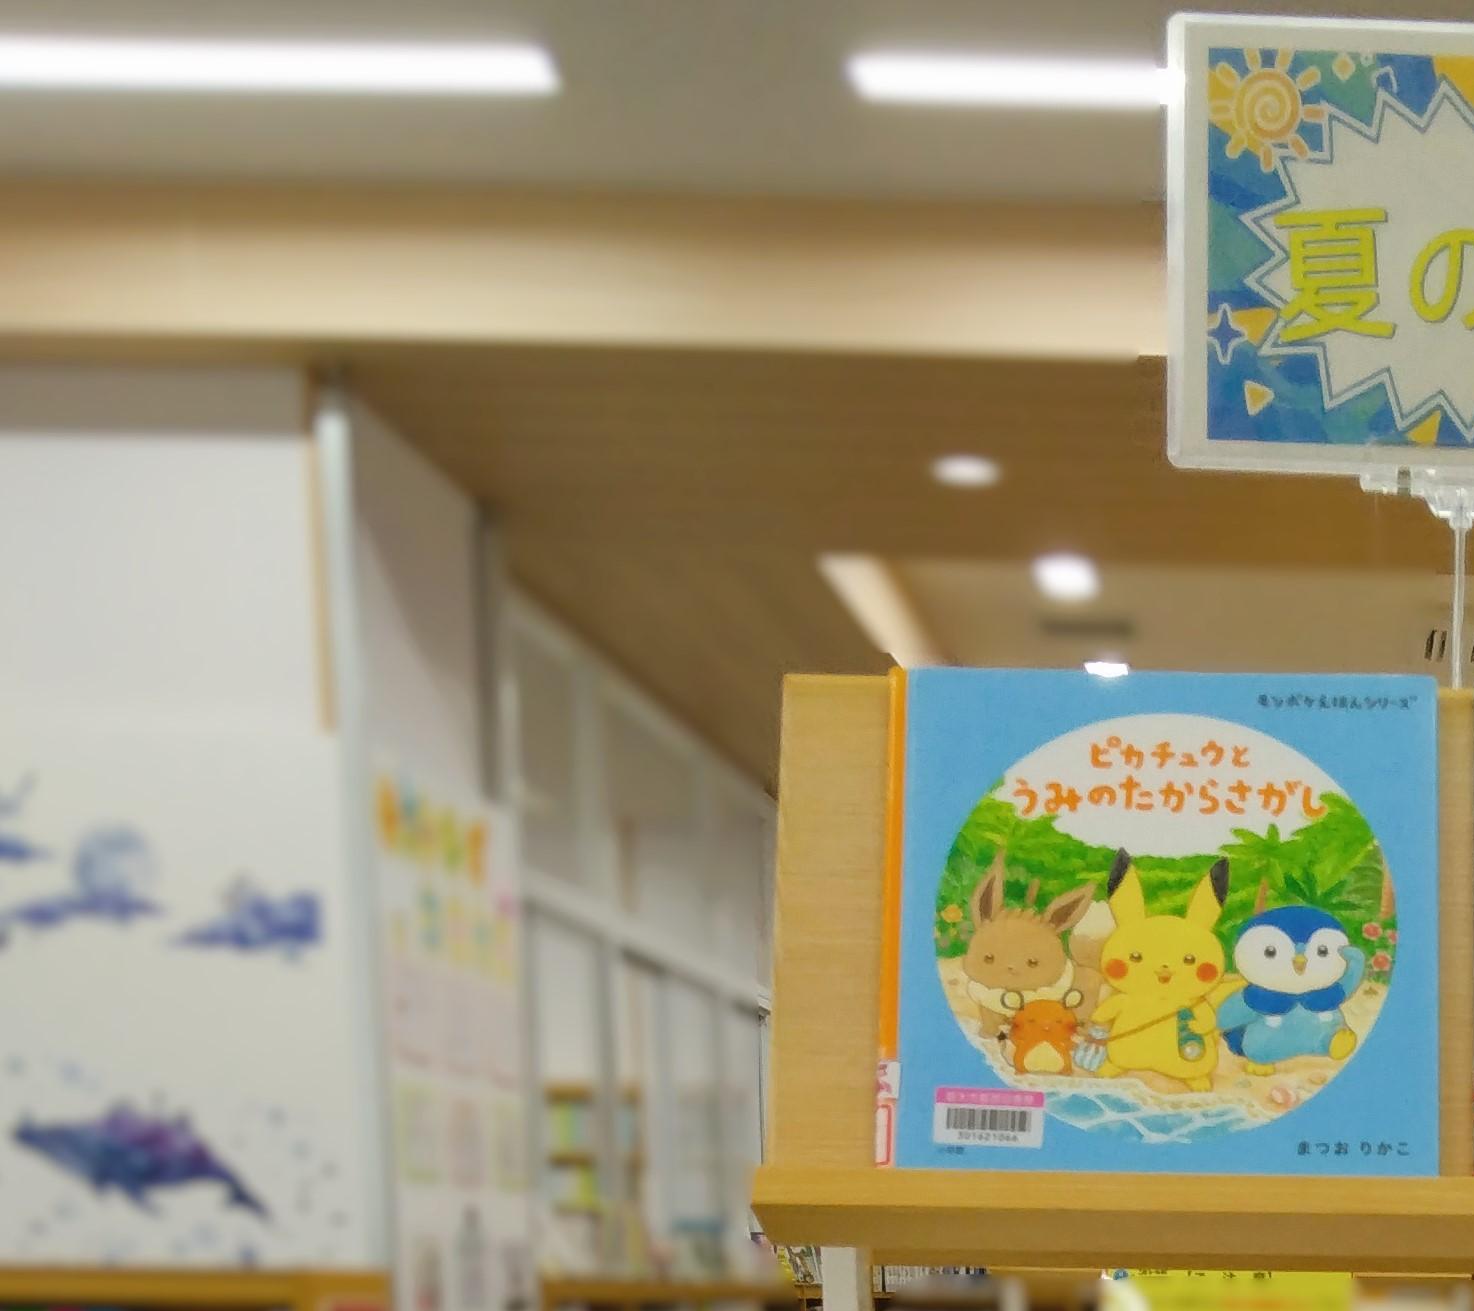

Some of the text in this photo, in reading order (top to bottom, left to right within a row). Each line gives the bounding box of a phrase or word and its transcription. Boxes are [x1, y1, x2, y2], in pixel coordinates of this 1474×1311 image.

[1088, 735, 1251, 770] ピカチュウと
[1012, 774, 1329, 819] うみのたからさがし
